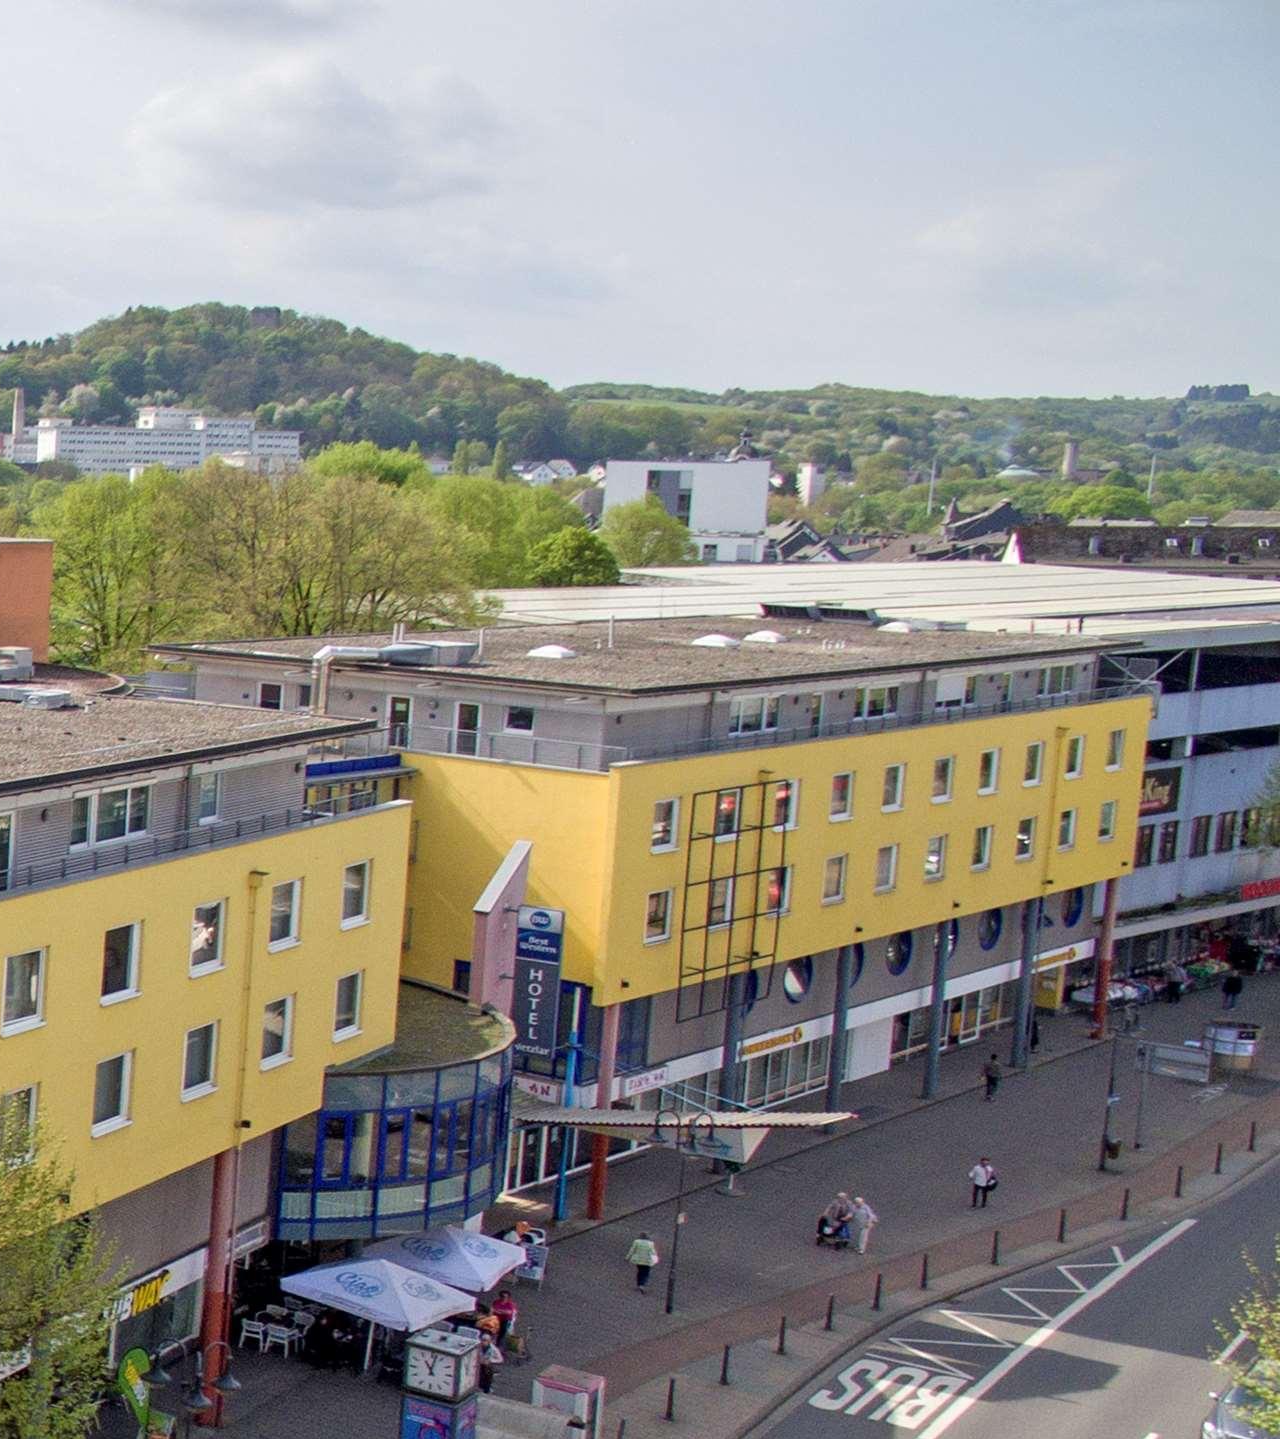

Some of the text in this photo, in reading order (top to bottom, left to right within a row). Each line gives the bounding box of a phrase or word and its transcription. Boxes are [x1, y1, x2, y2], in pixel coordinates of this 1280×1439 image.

[528, 968, 543, 1040] HOTEL
[102, 1268, 168, 1322] UBWAY
[807, 1358, 968, 1430] BUS
